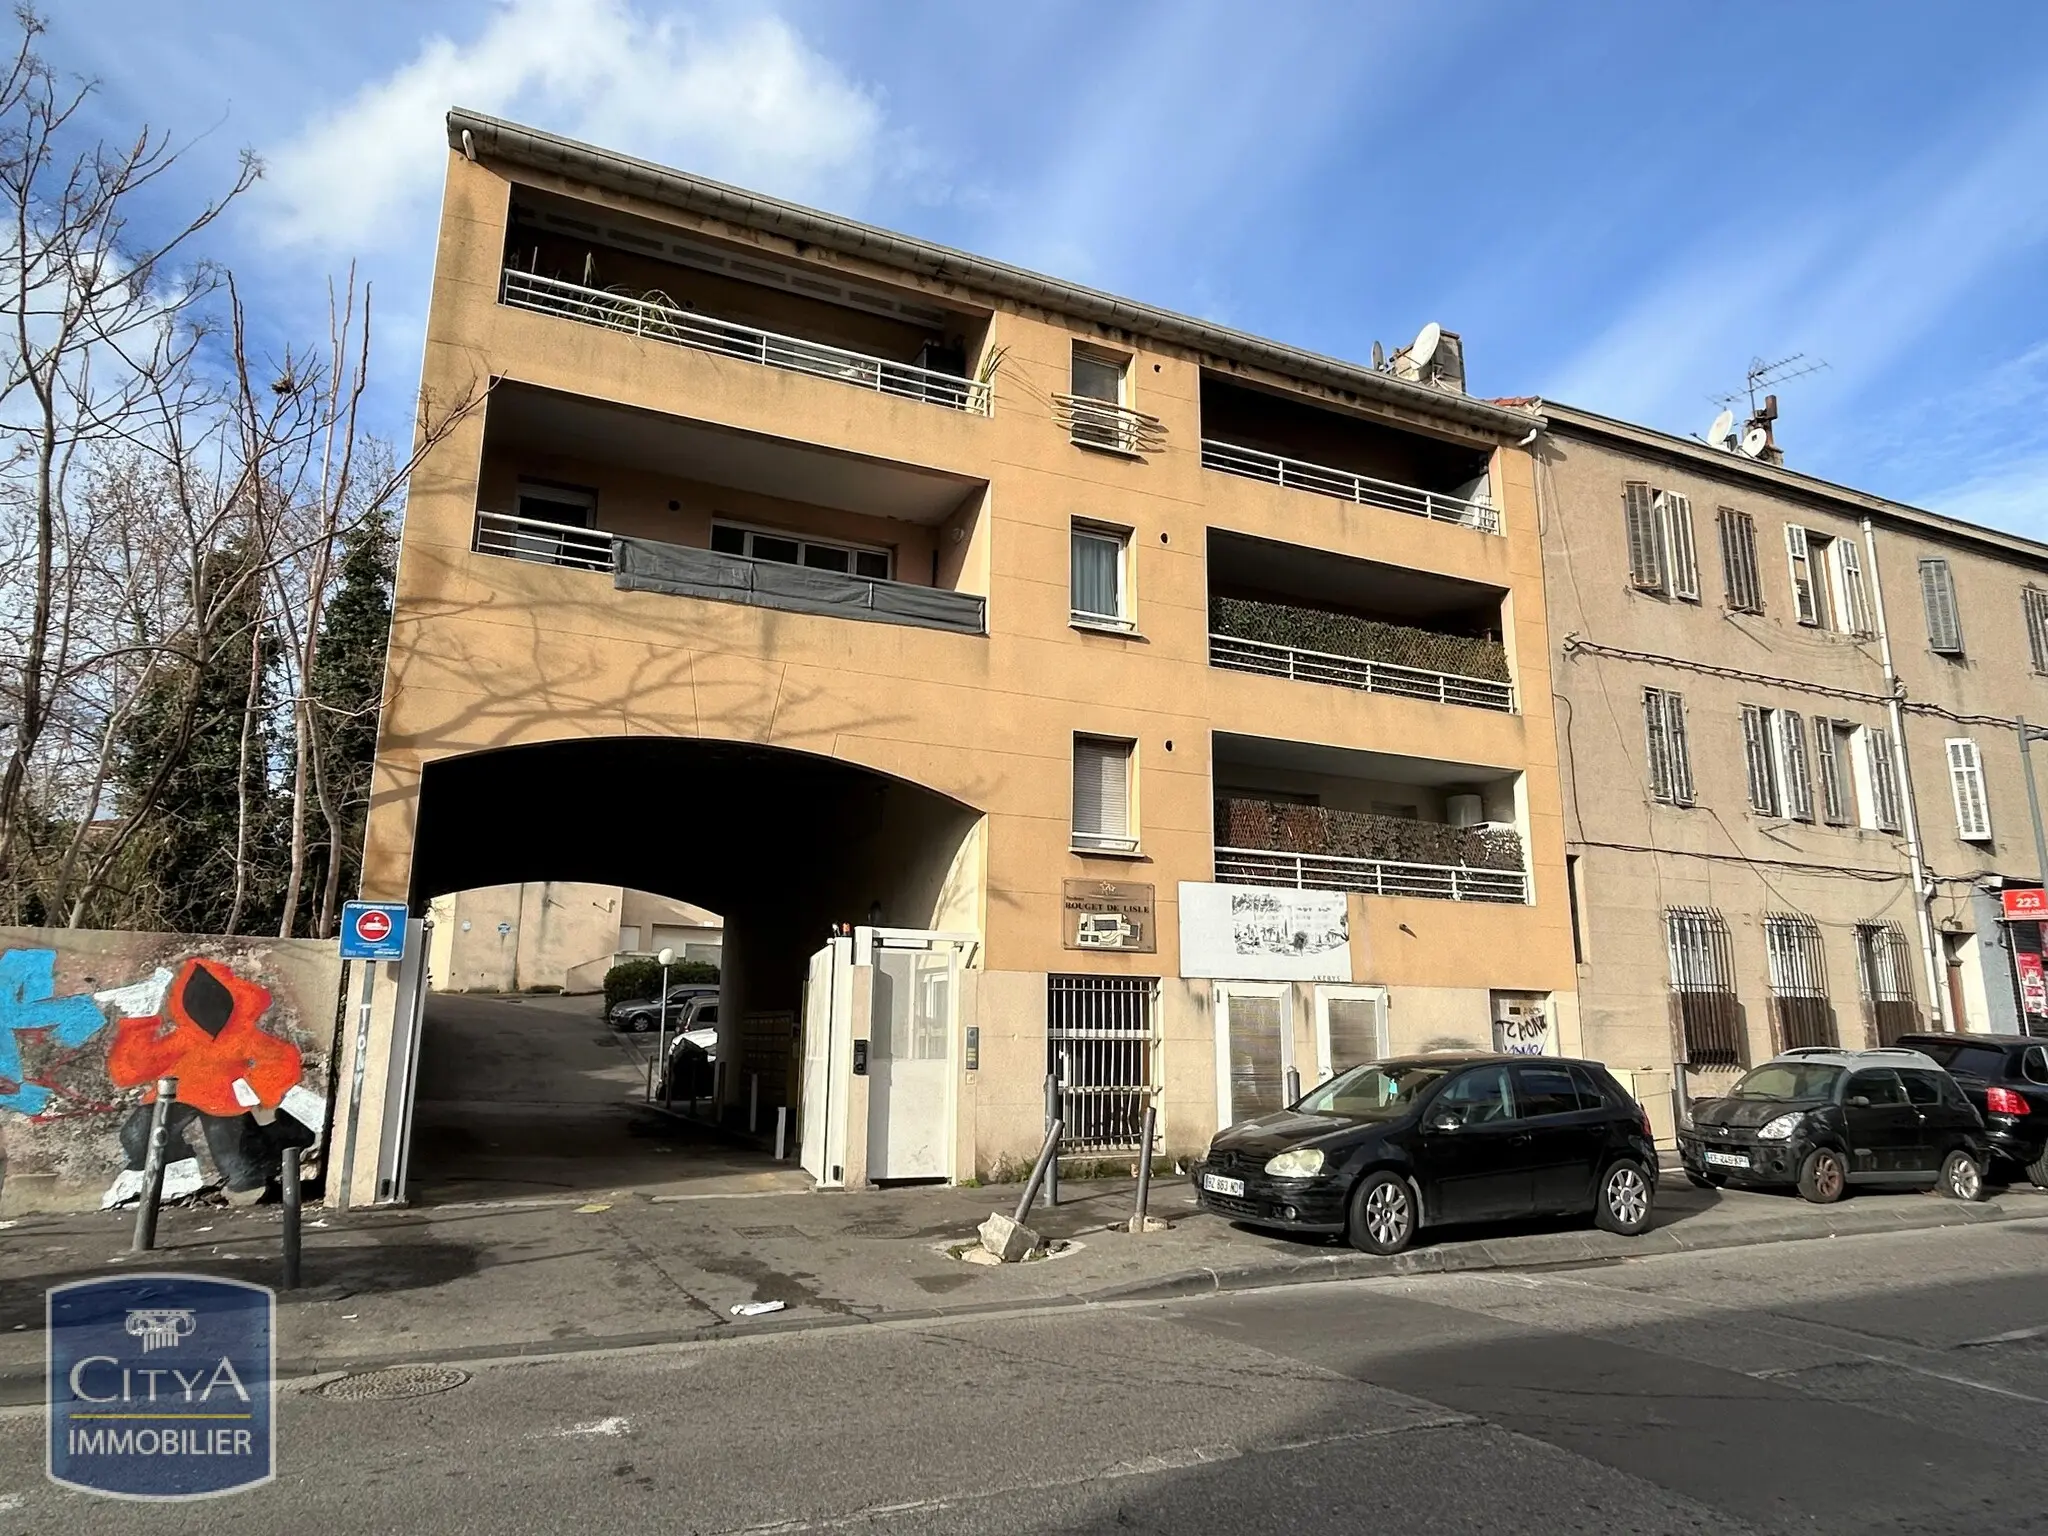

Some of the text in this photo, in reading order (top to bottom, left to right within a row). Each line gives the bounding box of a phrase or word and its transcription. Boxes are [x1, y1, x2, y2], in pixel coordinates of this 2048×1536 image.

[1065, 902, 1150, 914] ROUGET DE LISLE
[2016, 897, 2040, 908] 223
